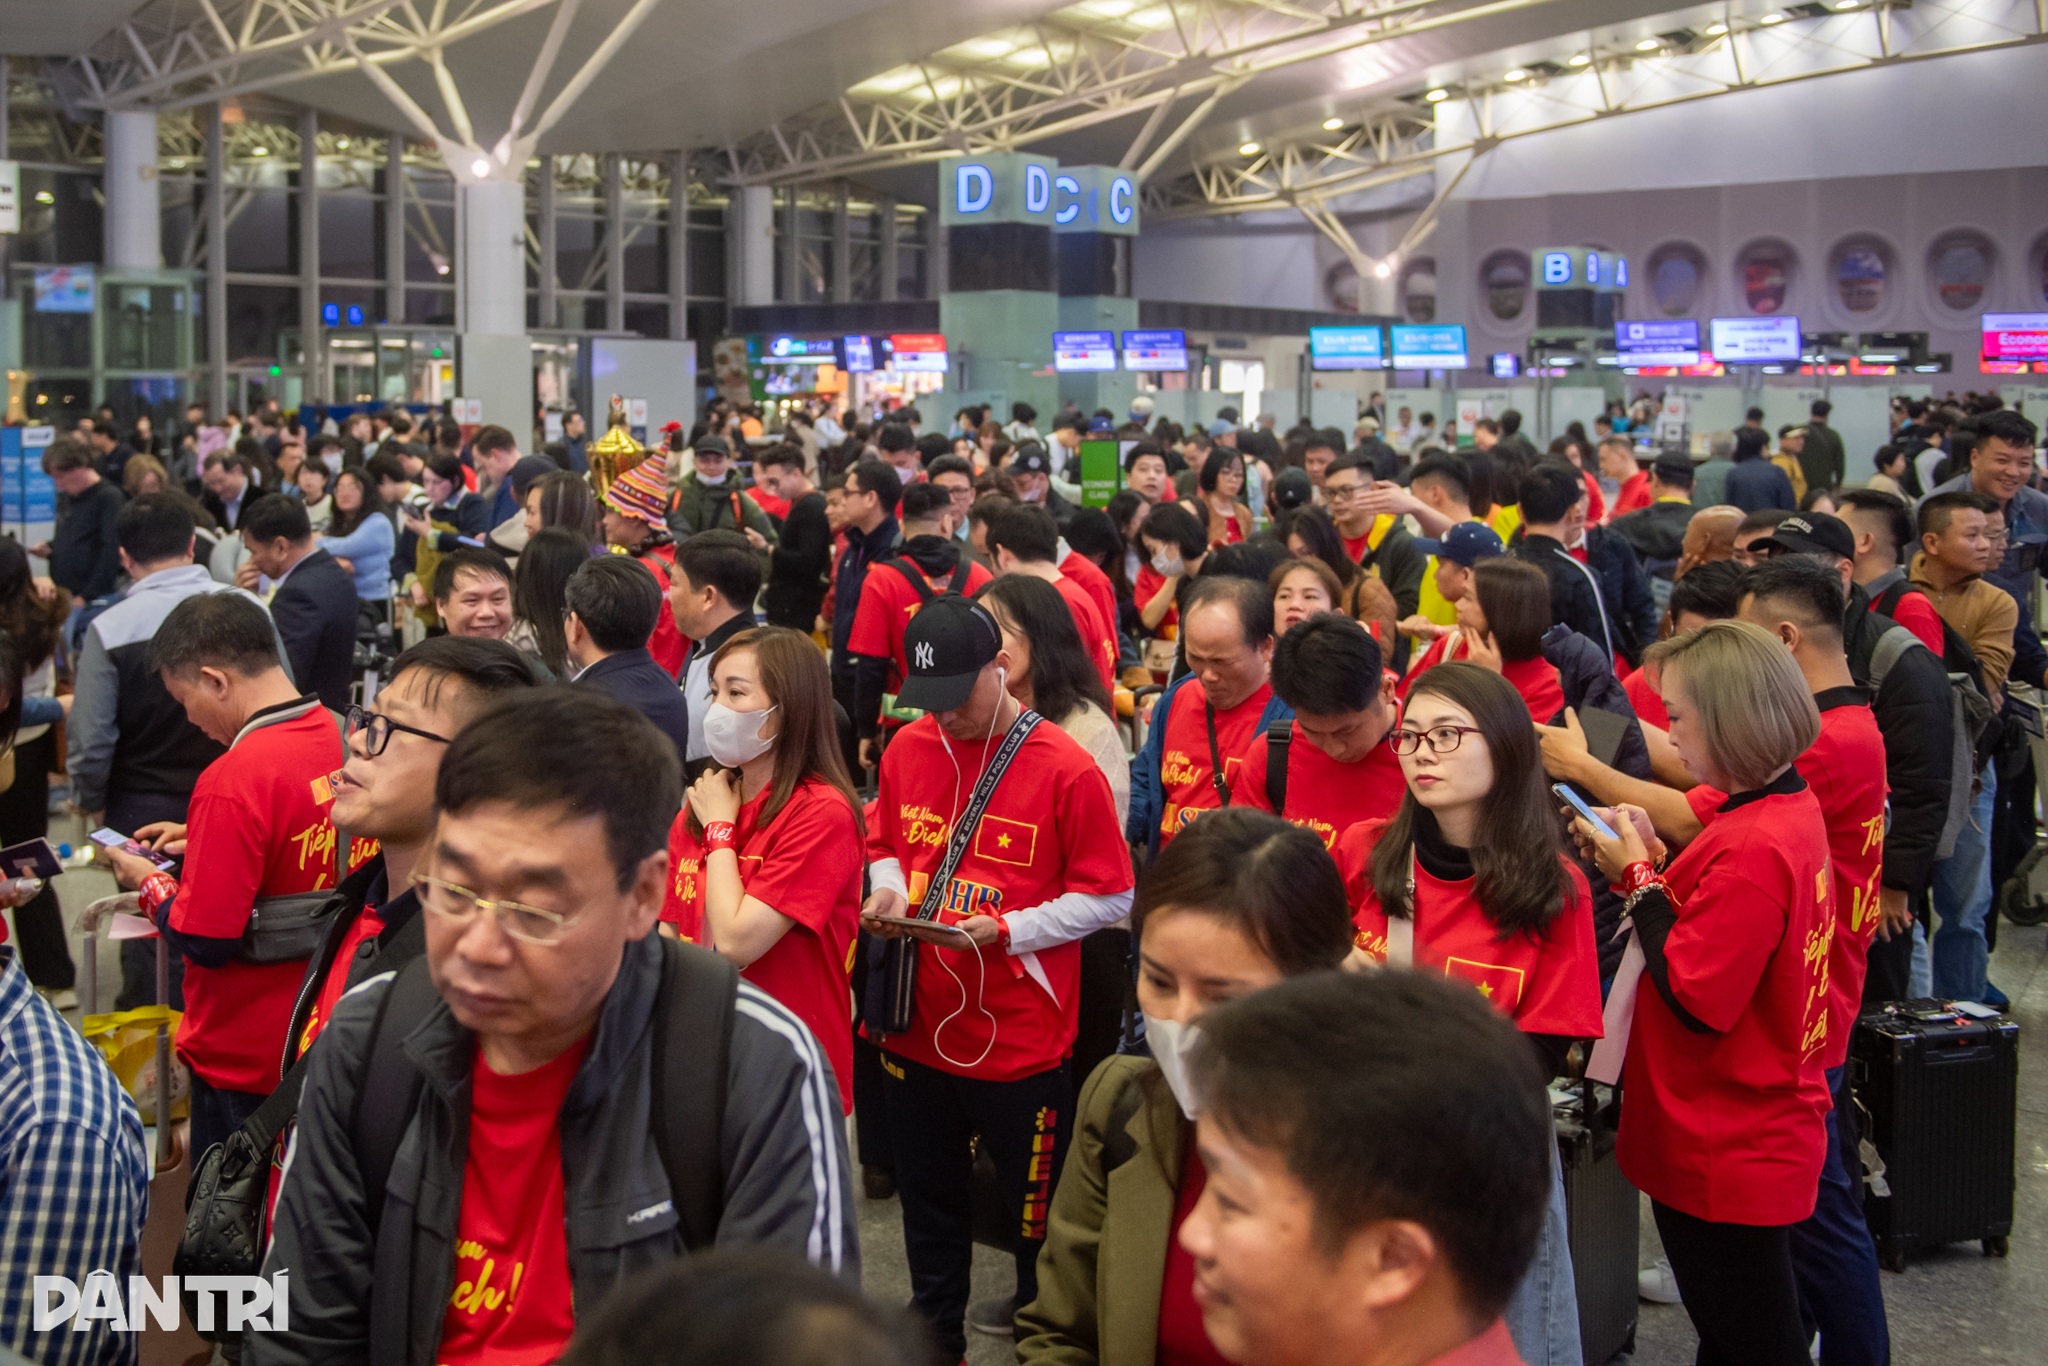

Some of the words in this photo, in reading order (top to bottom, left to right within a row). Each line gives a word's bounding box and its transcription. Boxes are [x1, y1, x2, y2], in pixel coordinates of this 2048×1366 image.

[957, 164, 993, 213] D
[1026, 164, 1049, 213] D
[1110, 177, 1133, 224] C
[1544, 252, 1572, 284] B
[1998, 332, 2048, 346] Econo
[914, 641, 935, 670] NY
[964, 799, 984, 831] BEVERLY
[980, 775, 995, 798] HILLS
[992, 753, 1007, 775] POLO
[1005, 732, 1020, 753] CLUB
[706, 822, 734, 842] Việt
[1021, 1133, 1056, 1240] KELME
[450, 1258, 525, 1315] ch!
